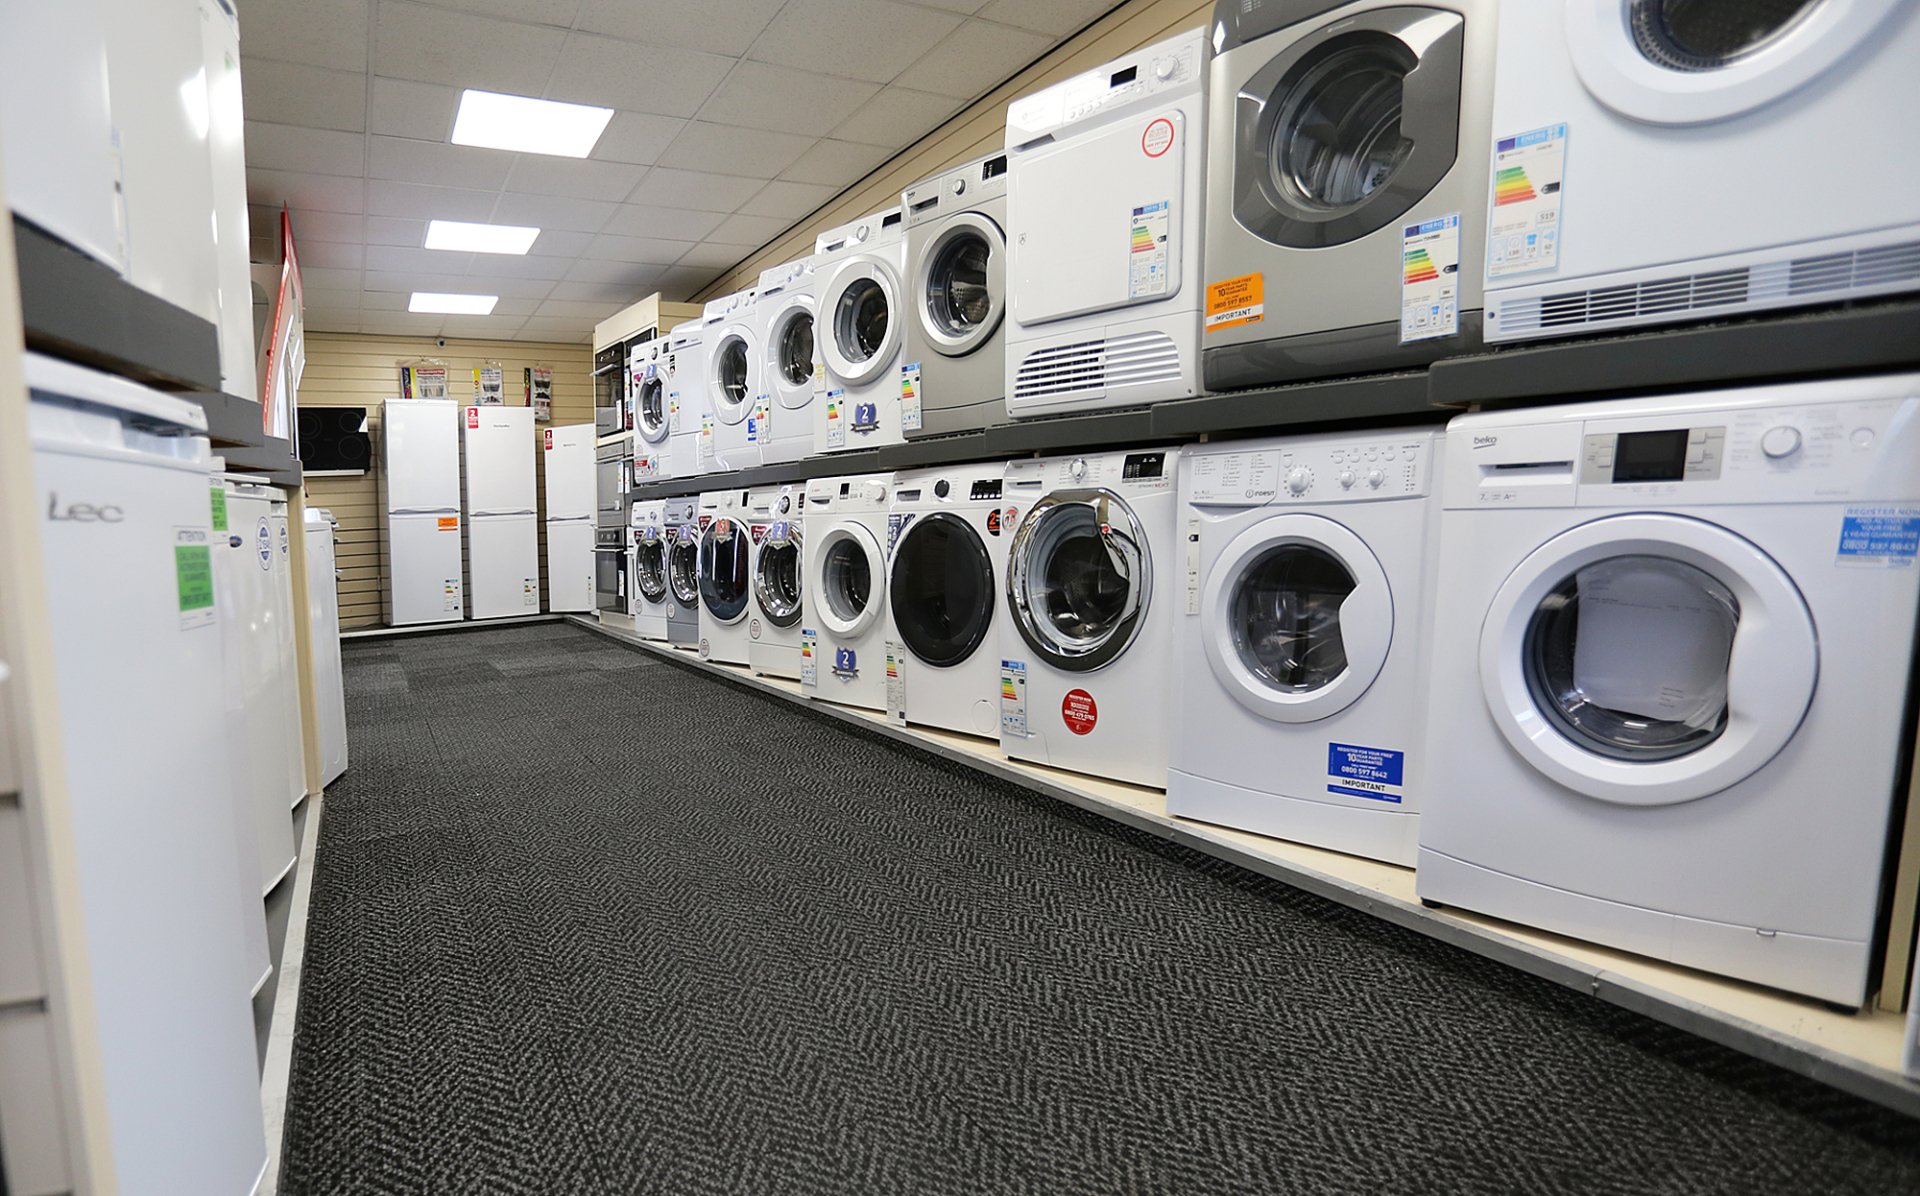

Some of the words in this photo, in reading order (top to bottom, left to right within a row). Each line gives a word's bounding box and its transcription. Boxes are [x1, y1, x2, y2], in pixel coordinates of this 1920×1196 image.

[1218, 288, 1226, 297] 10
[1215, 308, 1252, 322] IMPORTANT
[862, 406, 869, 420] 2
[1473, 435, 1498, 446] beko
[47, 490, 125, 524] Lec
[988, 512, 996, 525] 2
[682, 527, 687, 536] 2
[776, 524, 783, 535] 2
[1842, 540, 1868, 550] 0800
[1870, 542, 1888, 550] 597
[842, 652, 849, 664] 2
[1347, 752, 1356, 762] 10
[1341, 766, 1357, 774] 0800
[1371, 770, 1388, 779] 8642
[1342, 779, 1386, 791] IMPORTANT
